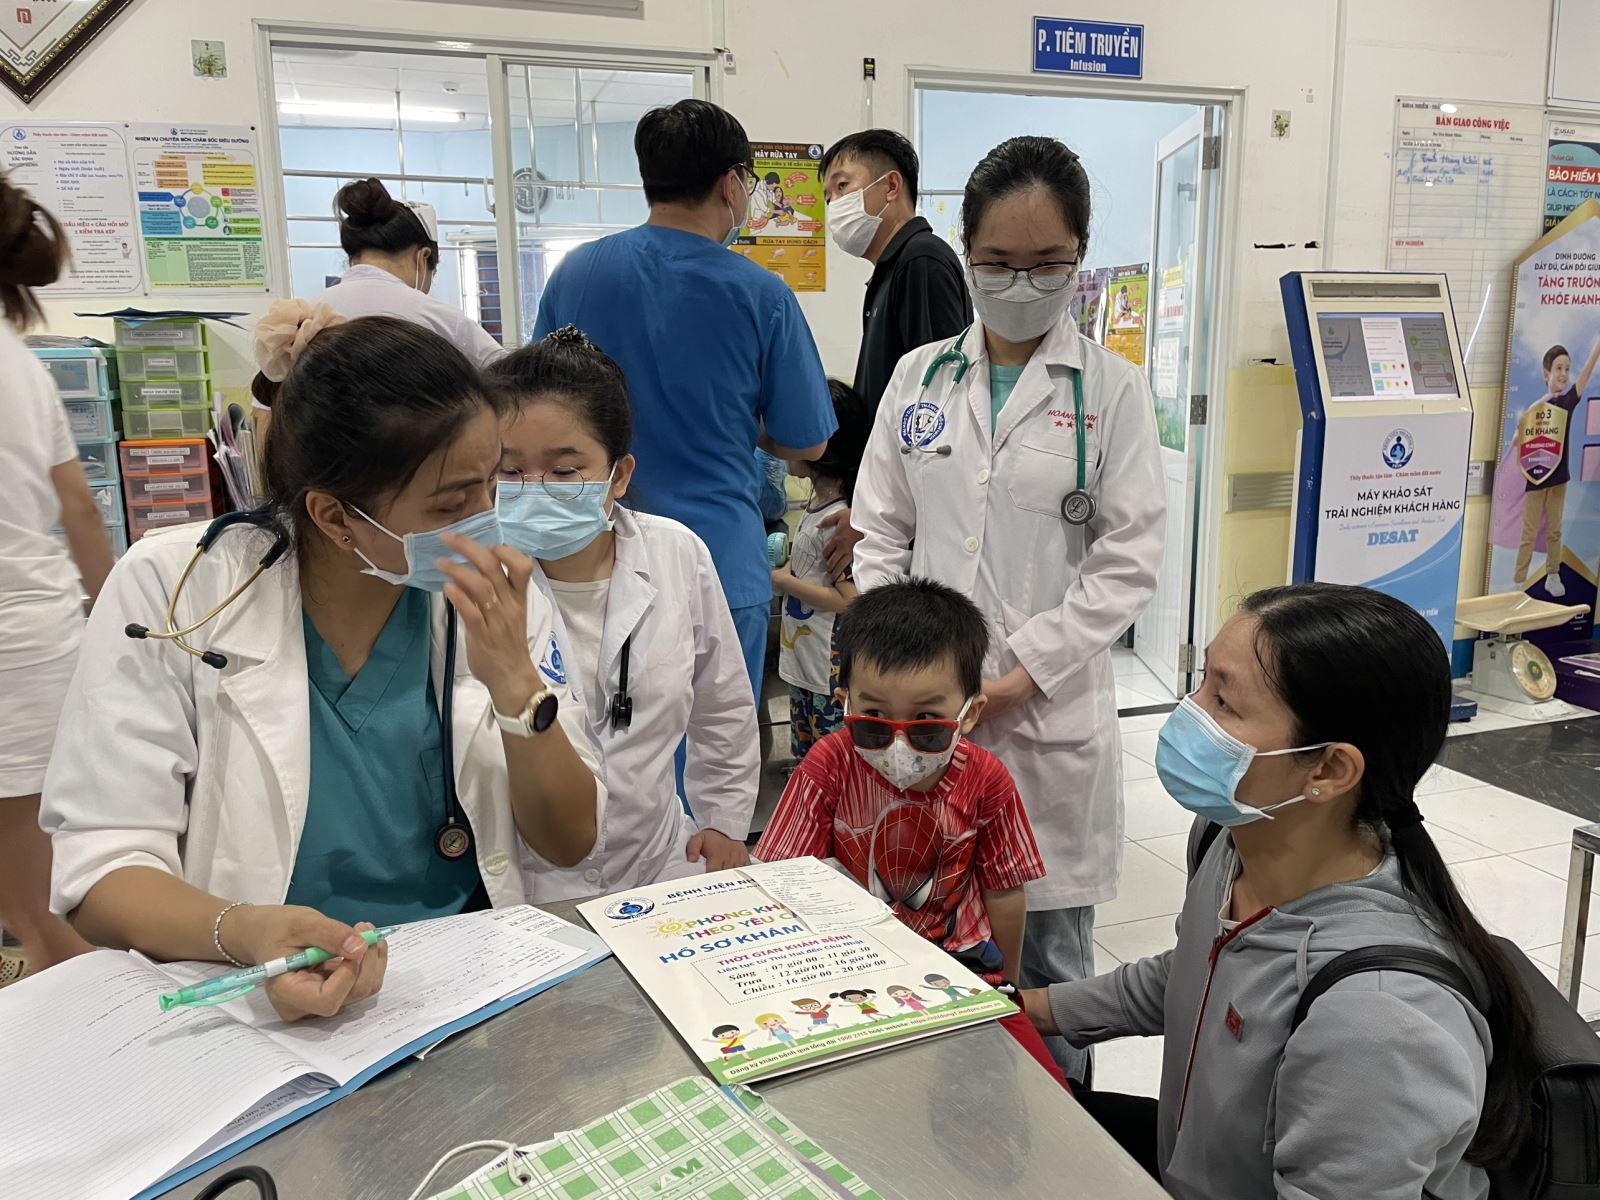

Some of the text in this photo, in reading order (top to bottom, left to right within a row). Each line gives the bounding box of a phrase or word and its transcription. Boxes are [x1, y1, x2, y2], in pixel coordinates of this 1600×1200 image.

[1038, 26, 1138, 58] P. TIÊM TRUYỀN
[1070, 59, 1107, 73] Infusion
[1453, 118, 1471, 127] GIAO
[1472, 117, 1491, 128] CÔNG
[1494, 119, 1510, 131] VIỆC
[755, 150, 769, 158] HÃY
[770, 150, 783, 158] RỬA
[1549, 166, 1569, 180] BẢO
[1547, 187, 1556, 197] LÀ
[1557, 188, 1578, 198] CÁCH
[1573, 252, 1596, 260] DƯỠNG
[1535, 261, 1547, 270] ĐẦY
[1560, 262, 1573, 270] CÂN
[1538, 274, 1564, 288] TĂNG
[1541, 291, 1569, 304] KHỎE
[1546, 409, 1552, 419] 3
[1535, 426, 1559, 436] KHÁNG
[1358, 485, 1432, 501] MÁY KHẢO SÁT
[1325, 499, 1460, 519] TRẢI NGHIỆM KHÁCH HÀNG
[1367, 528, 1418, 546] DESAT
[667, 887, 702, 899] BỆNH
[704, 881, 735, 891] VIỆN
[683, 924, 735, 940] THEO
[738, 915, 775, 928] YÊU
[685, 909, 753, 929] PHÒNG
[659, 924, 804, 963] HỒ SƠ KHÁM
[717, 934, 853, 967] THỜI GIAN KHÁM BỆNH
[717, 965, 737, 974] Liên
[739, 961, 755, 970] tục
[789, 950, 805, 958] Hai
[843, 939, 864, 948] Nhật
[728, 970, 756, 982] Sáng
[771, 963, 784, 971] 07
[786, 960, 804, 968] giờ
[841, 949, 857, 958] giờ
[735, 978, 762, 988] Trưa
[779, 970, 791, 978] 12
[793, 966, 811, 976] giờ
[849, 955, 865, 964] giờ
[742, 981, 775, 995] Chiều
[800, 973, 818, 983] giờ
[841, 966, 854, 974] 20
[856, 962, 873, 972] giờ
[730, 1065, 749, 1075] Đăng
[760, 1055, 779, 1064] khám
[780, 1050, 797, 1059] bệnh
